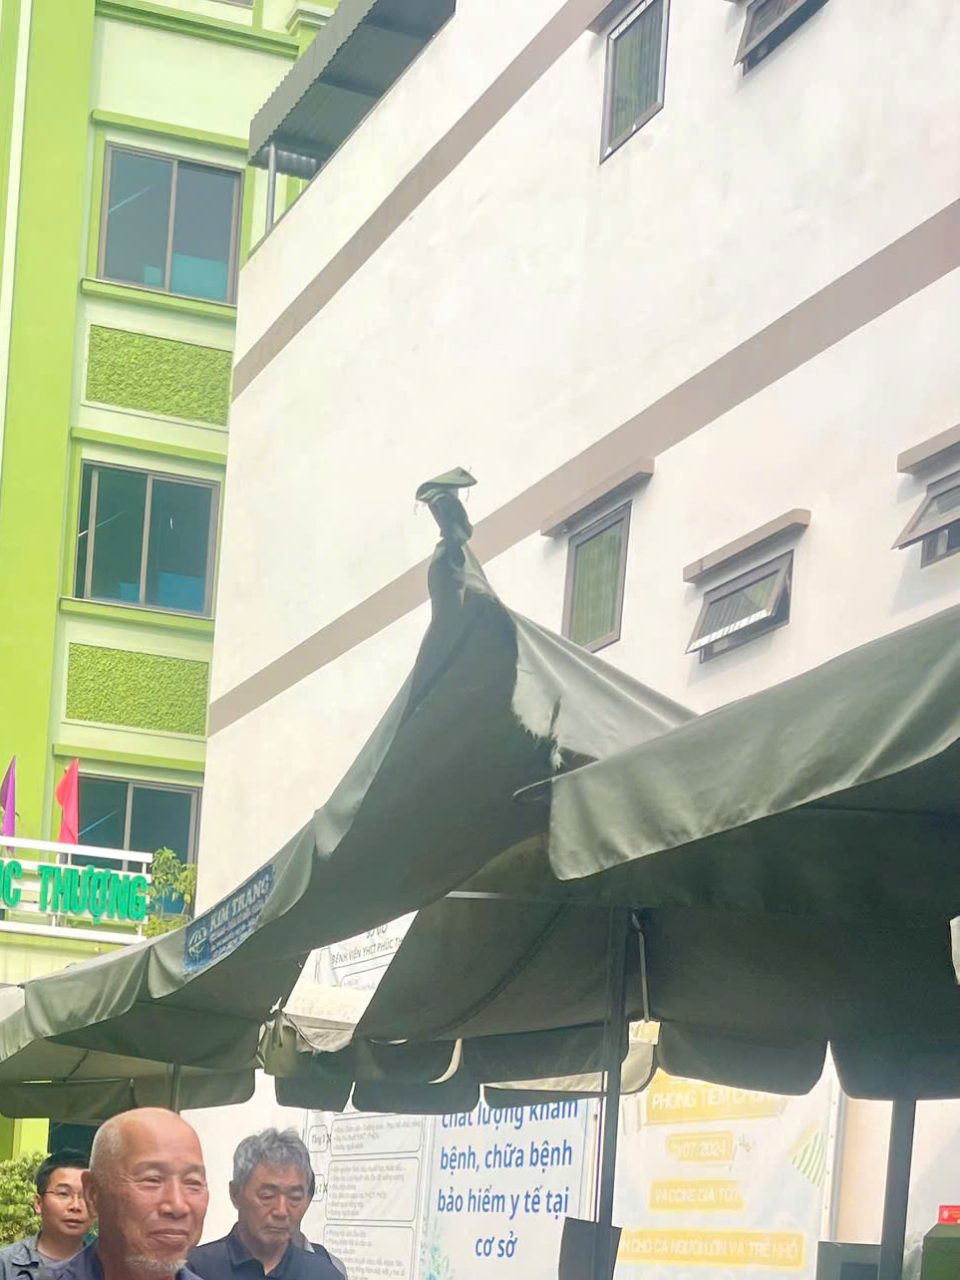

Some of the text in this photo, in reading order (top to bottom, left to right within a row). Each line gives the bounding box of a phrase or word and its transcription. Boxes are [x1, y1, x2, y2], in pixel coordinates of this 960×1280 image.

[37, 864, 149, 925] THƯỢNG
[440, 1145, 480, 1176] bệnh,
[484, 1143, 525, 1169] chữa
[529, 1139, 573, 1174] bệnh
[437, 1184, 569, 1221] bảo hiểm y tế tại
[475, 1230, 518, 1258] cơ sở
